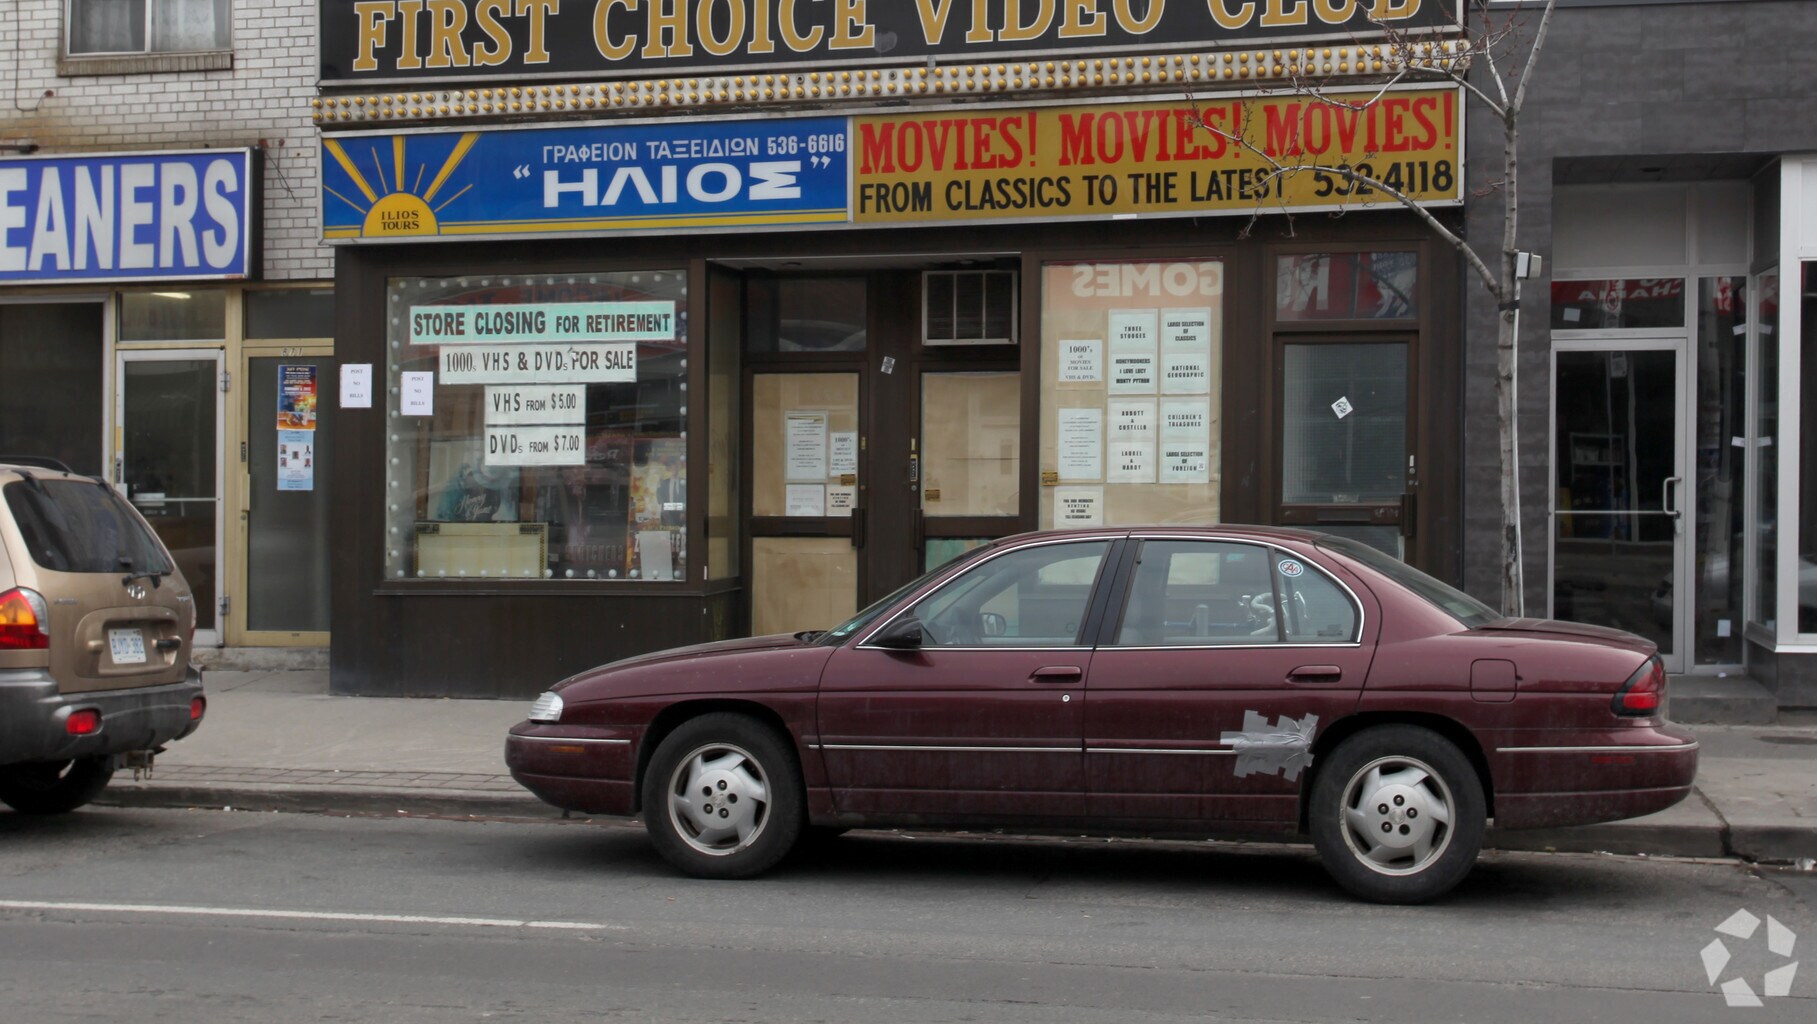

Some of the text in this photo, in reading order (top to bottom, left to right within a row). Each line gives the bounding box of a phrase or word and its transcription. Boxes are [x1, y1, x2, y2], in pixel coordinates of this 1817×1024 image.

[859, 92, 1453, 174] MOVIES! MOVIES! MOVIES!
[542, 142, 637, 164] ΓΡΑΦΕΙΟΝ
[767, 133, 845, 156] 536-6616
[859, 181, 932, 213] FROM
[945, 176, 1071, 210] CLASSICS
[1082, 174, 1117, 206] TO
[1128, 172, 1178, 204] THE
[1190, 168, 1285, 202] LATEST
[0, 159, 239, 271] EANERS
[381, 210, 419, 221] ILIOS
[381, 221, 420, 231] TOURS
[414, 310, 671, 336] STORE CLOSING FOR RETIREMENT
[482, 351, 510, 371] VHS
[517, 351, 528, 371] &
[572, 350, 599, 370] FOR
[605, 350, 633, 370] SALE
[493, 392, 521, 412] VHS
[526, 400, 546, 411] FROM
[490, 434, 523, 454] DVDs
[529, 441, 549, 452] FROM
